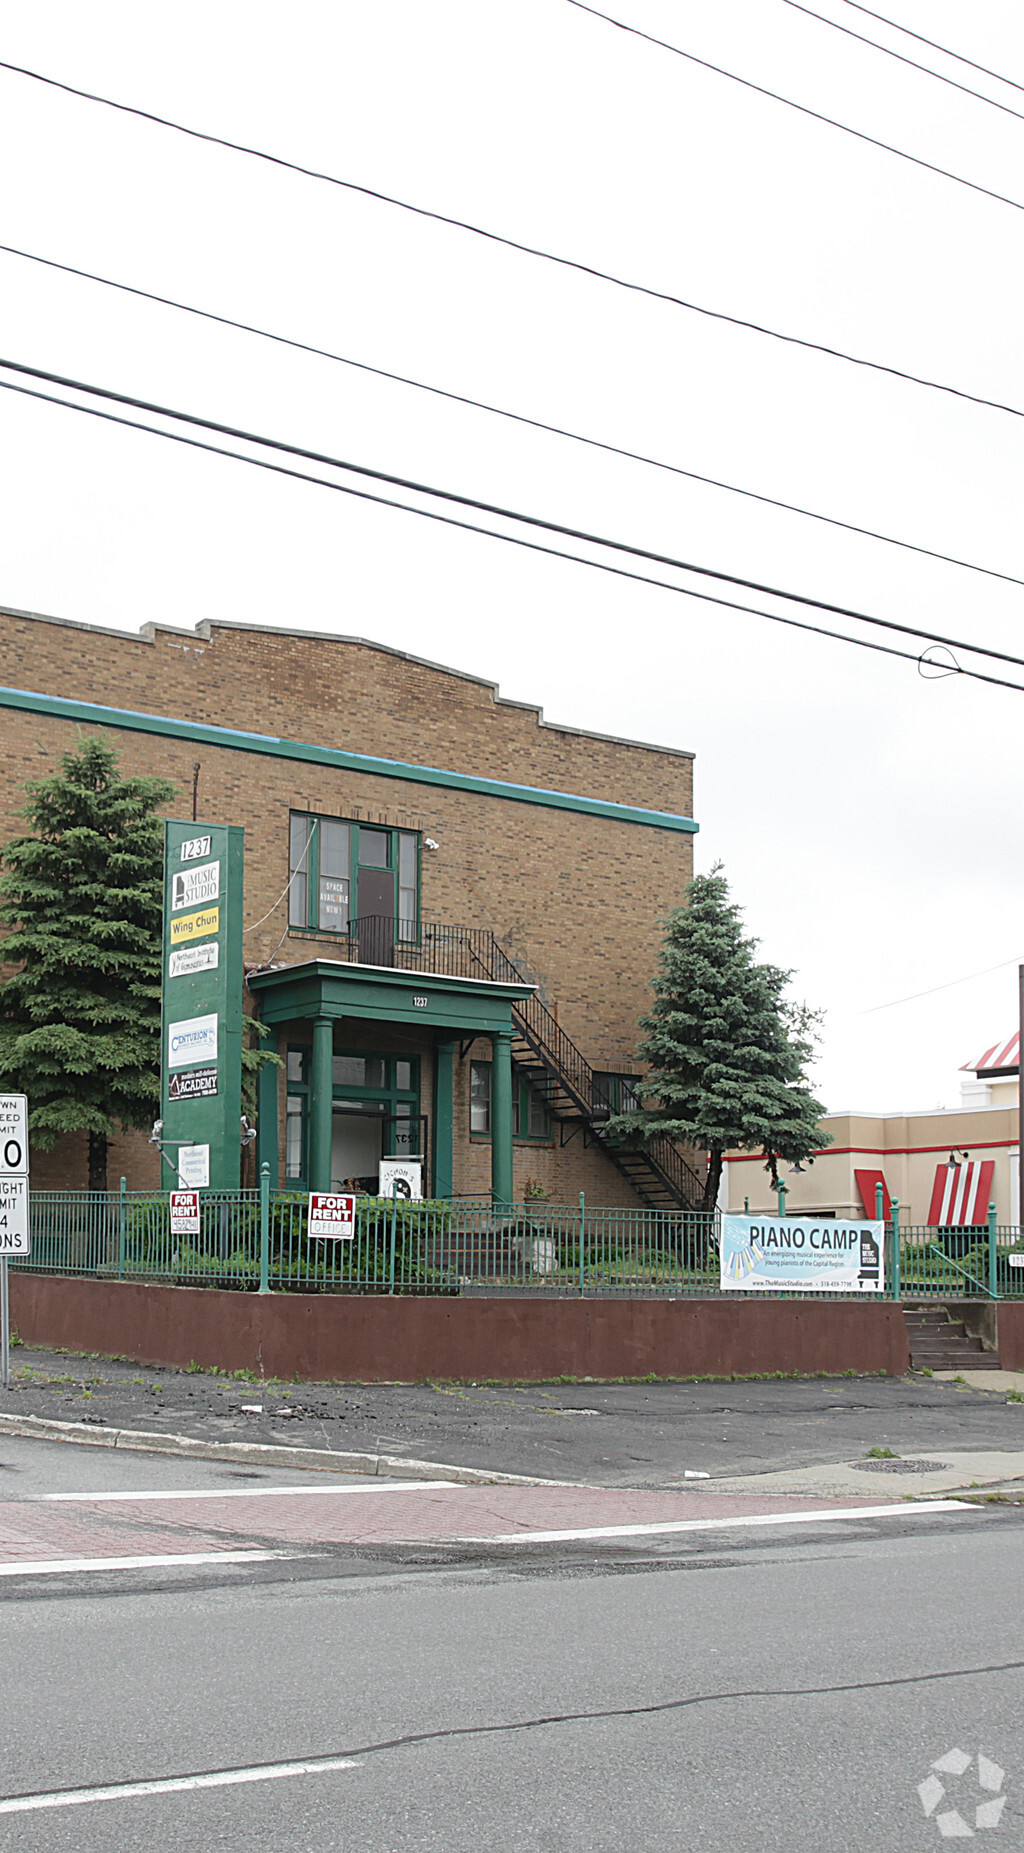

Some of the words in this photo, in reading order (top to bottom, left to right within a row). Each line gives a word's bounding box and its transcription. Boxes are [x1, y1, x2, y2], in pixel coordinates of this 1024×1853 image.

[182, 837, 210, 860] 1237
[190, 867, 217, 887] MUSIC
[186, 881, 217, 902] STUDIO
[326, 882, 343, 892] SPACE
[173, 920, 193, 934] Wing
[196, 914, 217, 928] Chun
[413, 996, 428, 1008] 1237
[171, 1029, 208, 1052] CENTURION
[180, 1075, 218, 1093] ACADEMY
[174, 1194, 194, 1206] FOR
[317, 1197, 347, 1209] FOR
[172, 1205, 197, 1217] RENT
[312, 1208, 352, 1221] RENT
[0, 1214, 8, 1228] 4
[314, 1221, 347, 1234] OFFICE
[749, 1226, 805, 1248] PIANO
[809, 1228, 858, 1250] CAMP
